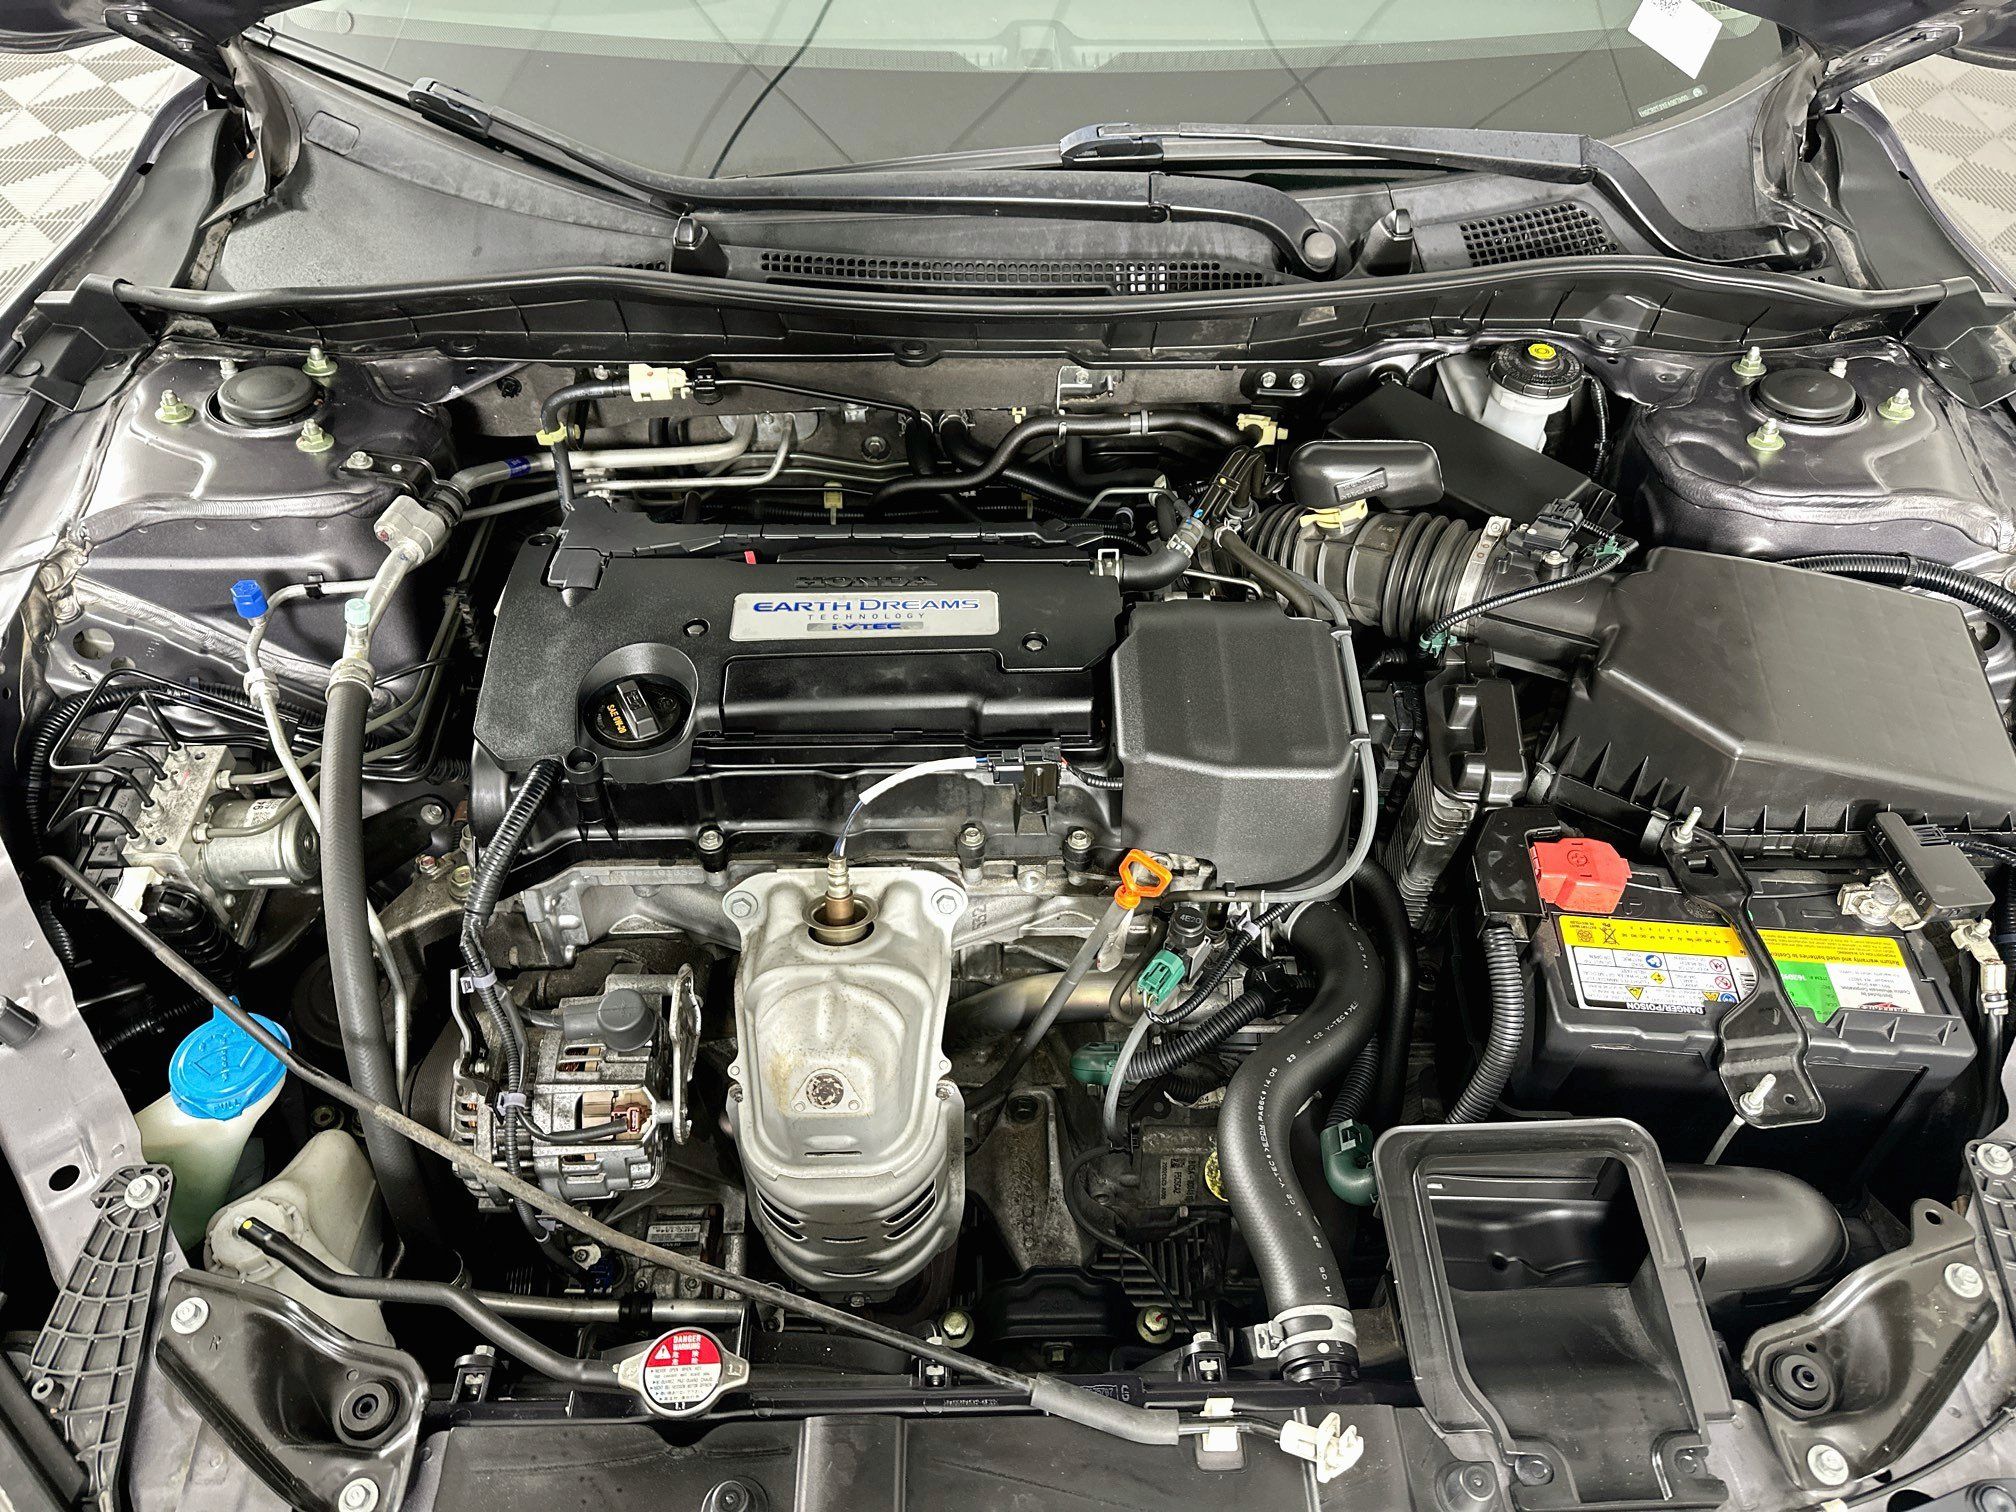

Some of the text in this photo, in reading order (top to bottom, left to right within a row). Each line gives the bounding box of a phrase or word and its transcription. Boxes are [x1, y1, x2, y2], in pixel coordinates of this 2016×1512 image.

[795, 576, 938, 588] HONDA
[753, 599, 979, 612] EARTH DREAMS
[607, 704, 627, 734] SAE 0W-20
[1626, 1001, 1704, 1014] DANGER/POISON
[1269, 1161, 1285, 1188] Y-TEC
[673, 1334, 702, 1343] DANGER
[1121, 1384, 1130, 1402] G
